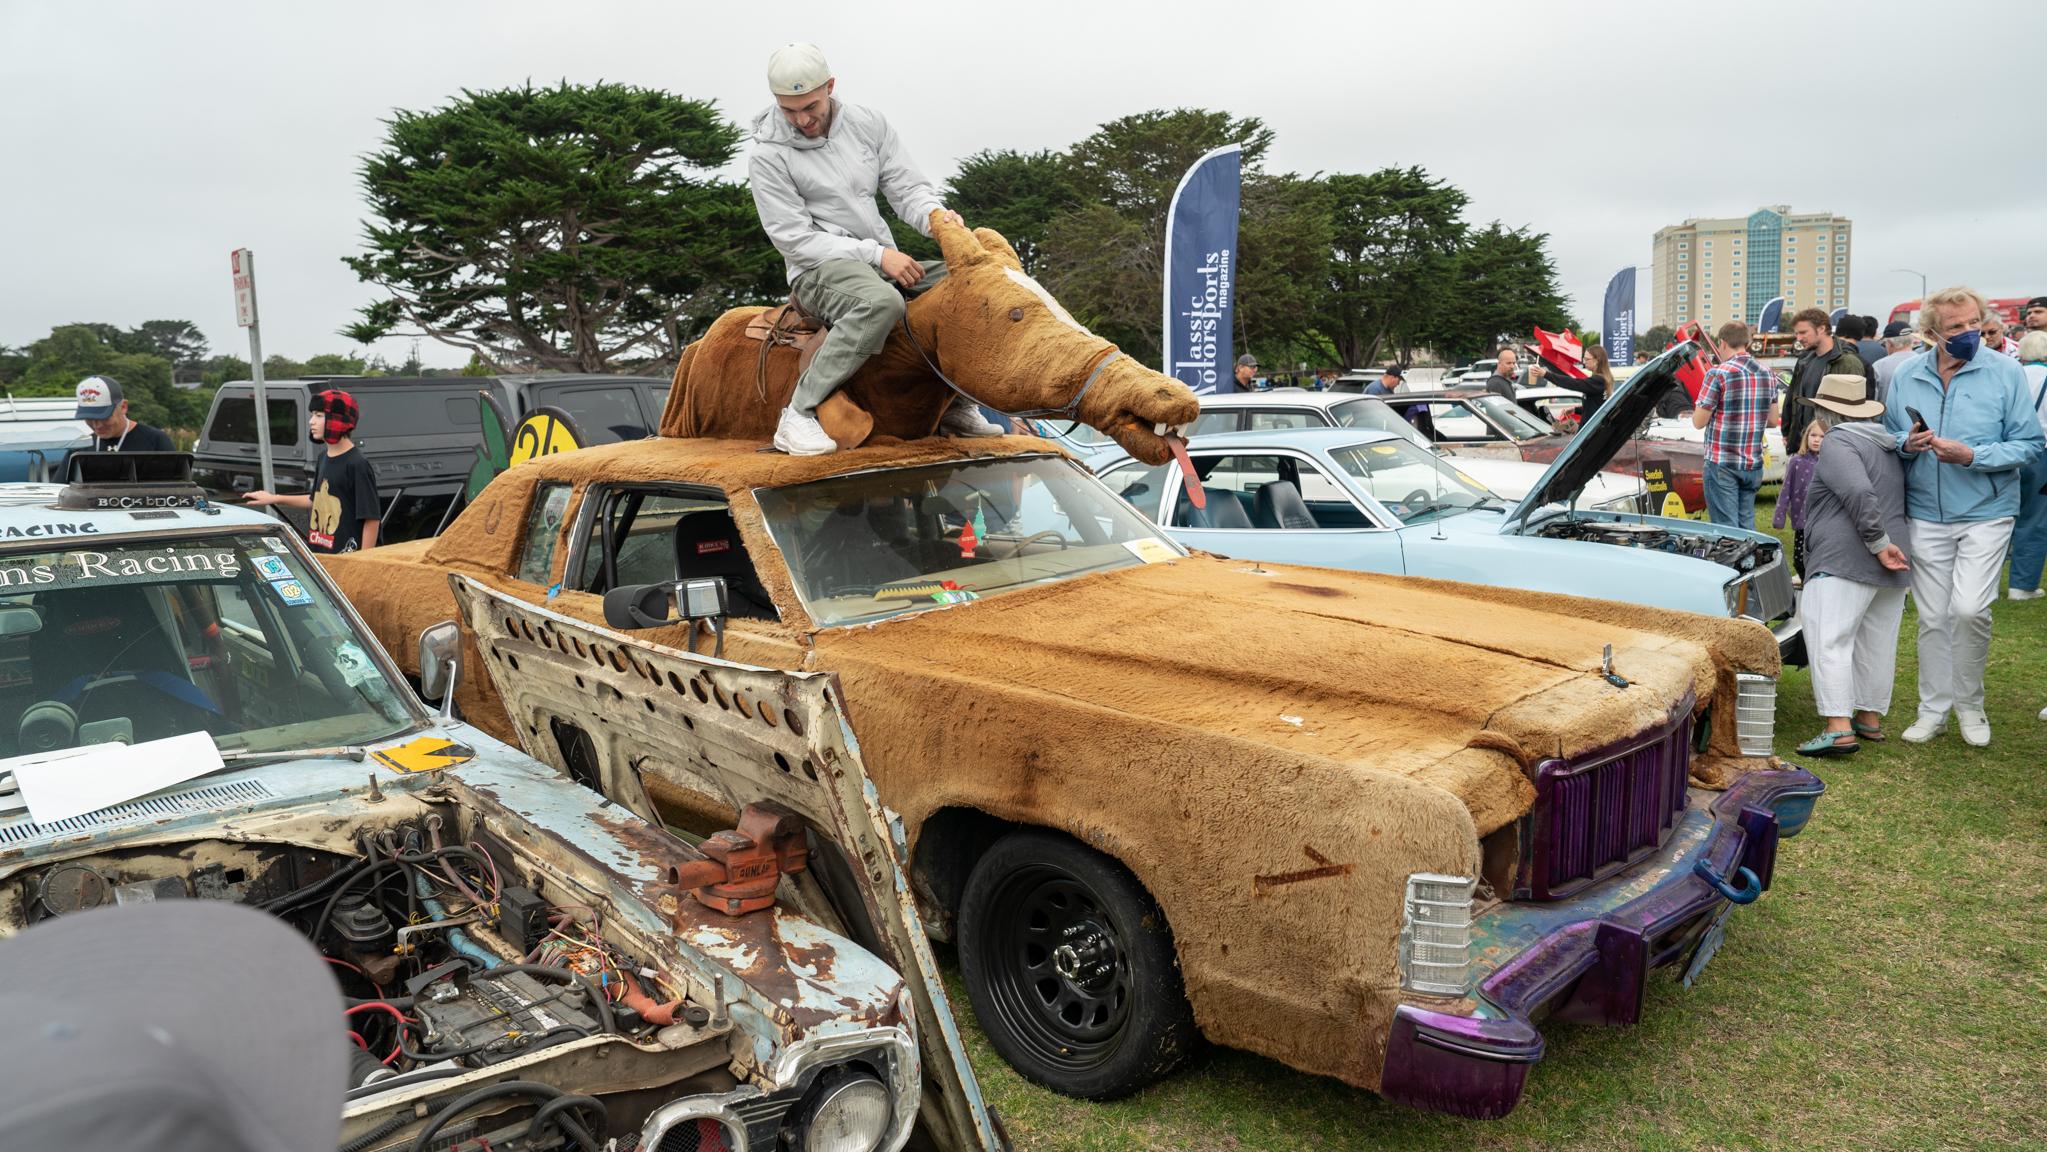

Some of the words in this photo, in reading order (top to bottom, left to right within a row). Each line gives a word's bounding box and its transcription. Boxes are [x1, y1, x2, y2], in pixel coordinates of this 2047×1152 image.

[1219, 249, 1229, 308] magazine
[98, 497, 143, 508] BOCK
[0, 522, 99, 537] ACING
[71, 548, 241, 578] Racing
